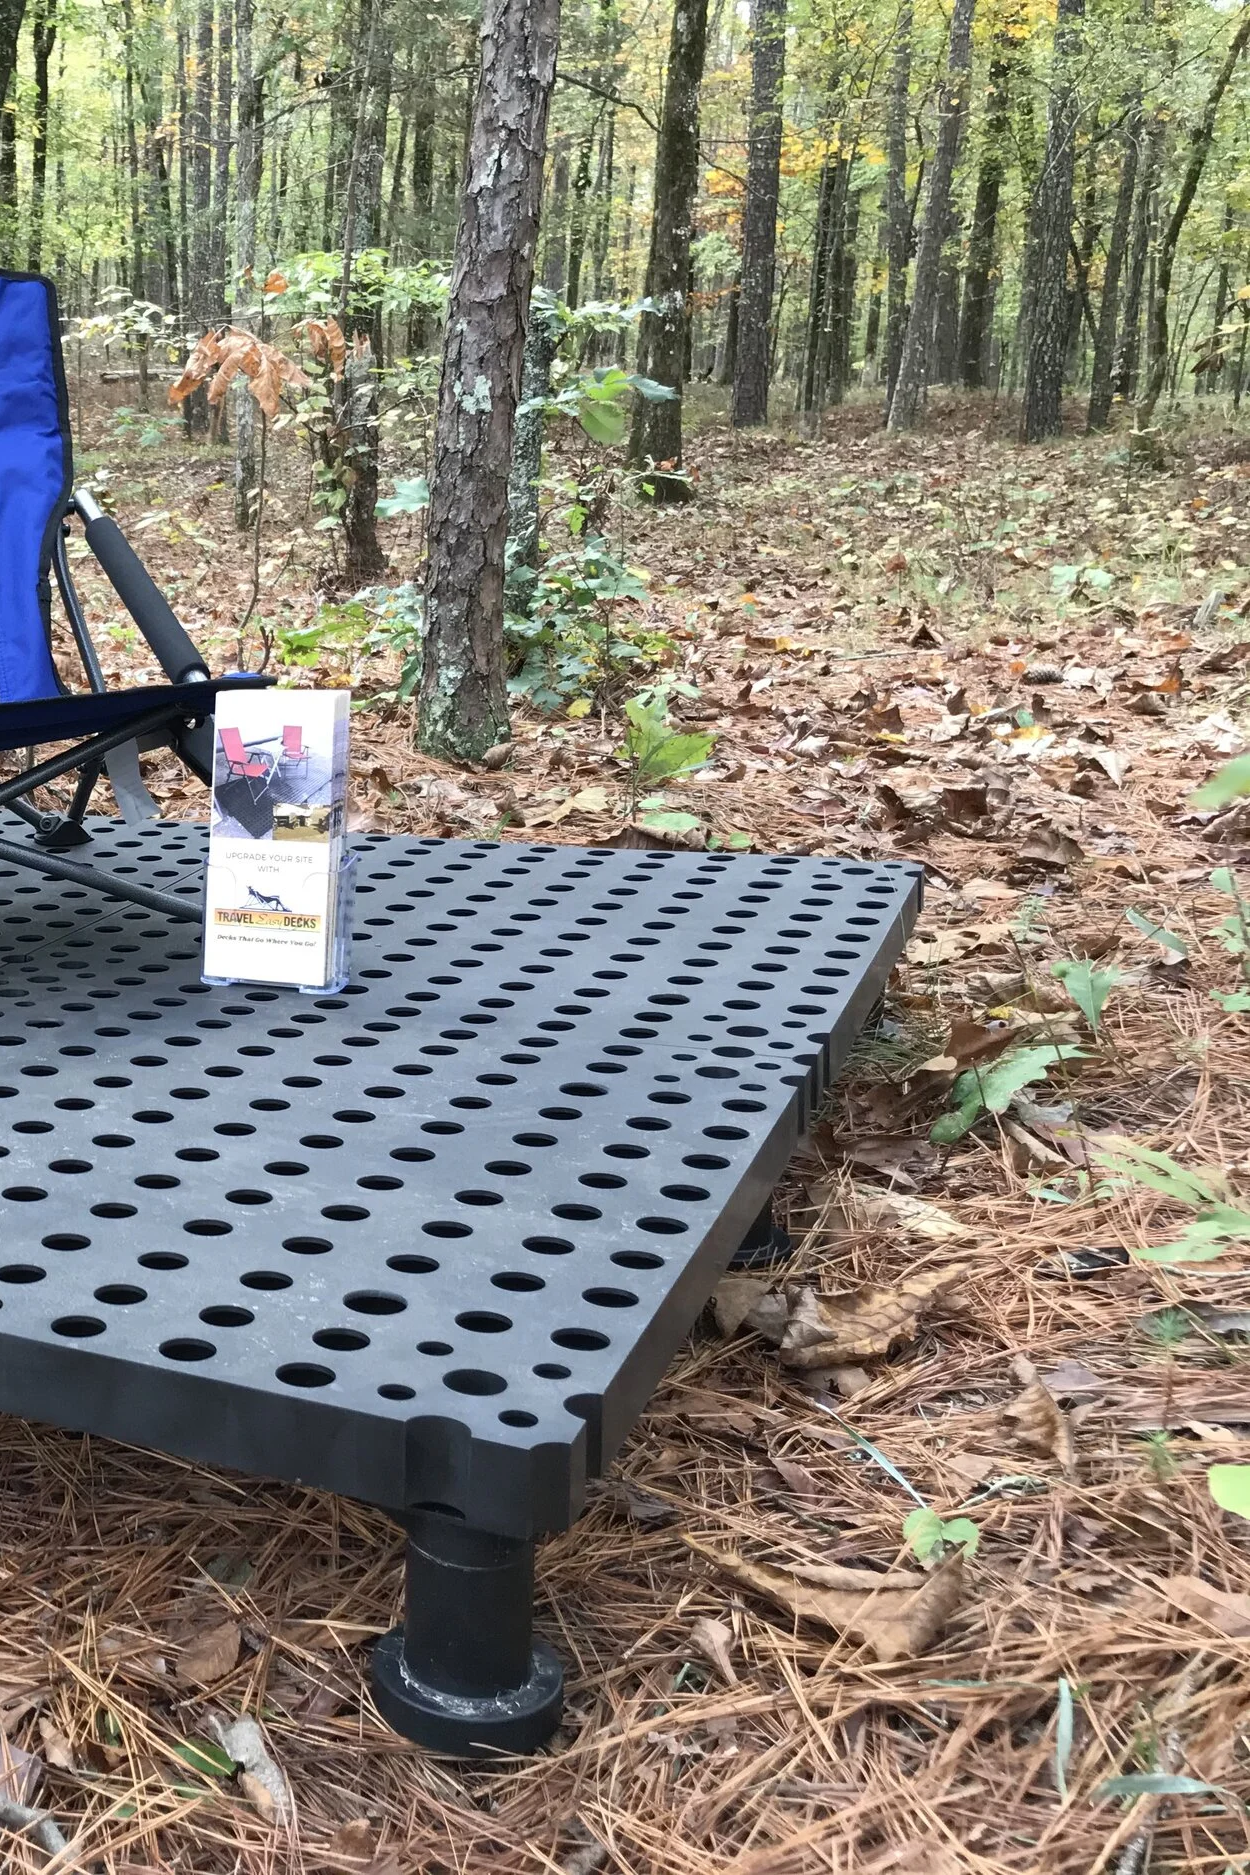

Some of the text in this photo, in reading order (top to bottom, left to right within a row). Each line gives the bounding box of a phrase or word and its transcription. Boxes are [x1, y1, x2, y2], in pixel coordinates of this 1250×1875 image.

[225, 852, 313, 863] UPGRADE YOUR SITE
[217, 911, 317, 929] TRAVEL Easy DECKS
